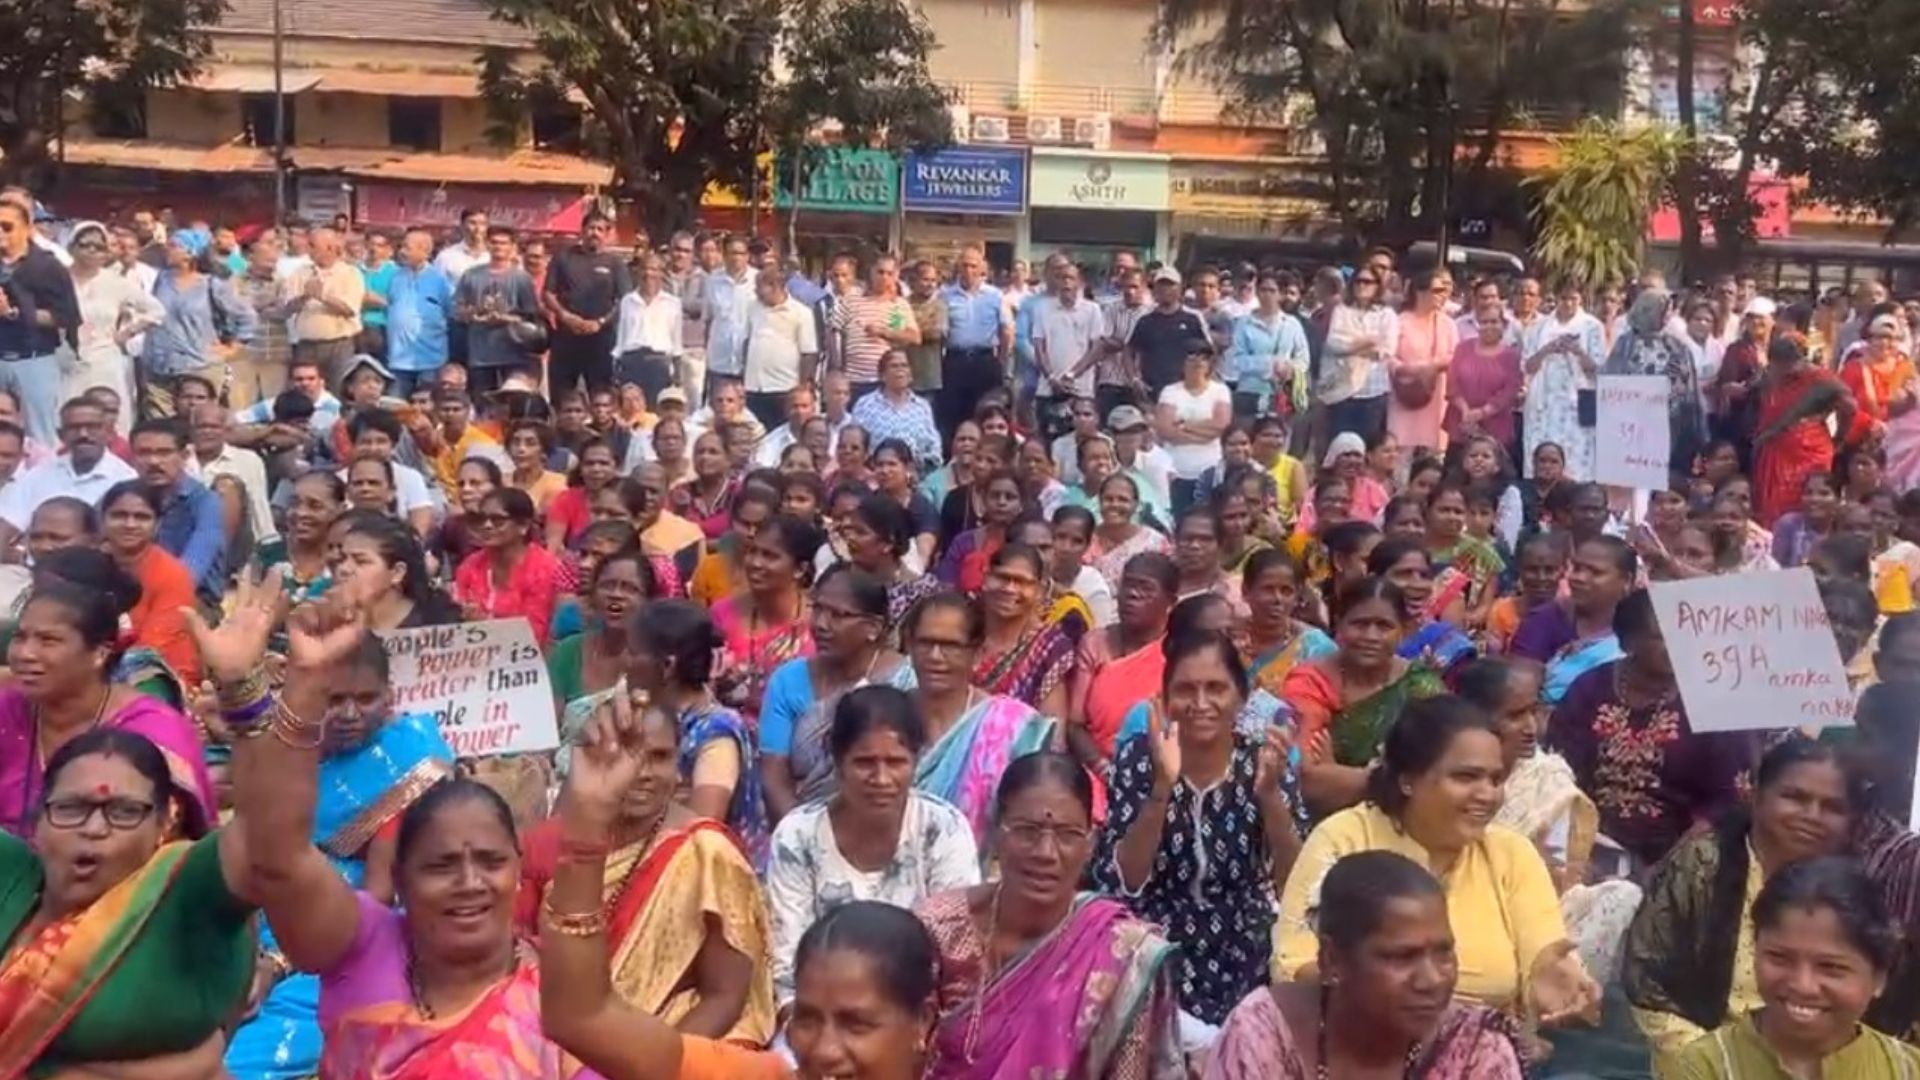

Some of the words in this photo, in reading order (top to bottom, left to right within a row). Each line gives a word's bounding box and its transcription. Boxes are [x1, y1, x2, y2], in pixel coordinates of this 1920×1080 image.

[917, 163, 1012, 184] REVANKAR
[927, 182, 1002, 197] JEWELLERS
[1677, 601, 1782, 636] AMKAM
[510, 641, 538, 664] is
[487, 669, 538, 692] than
[483, 698, 509, 723] in
